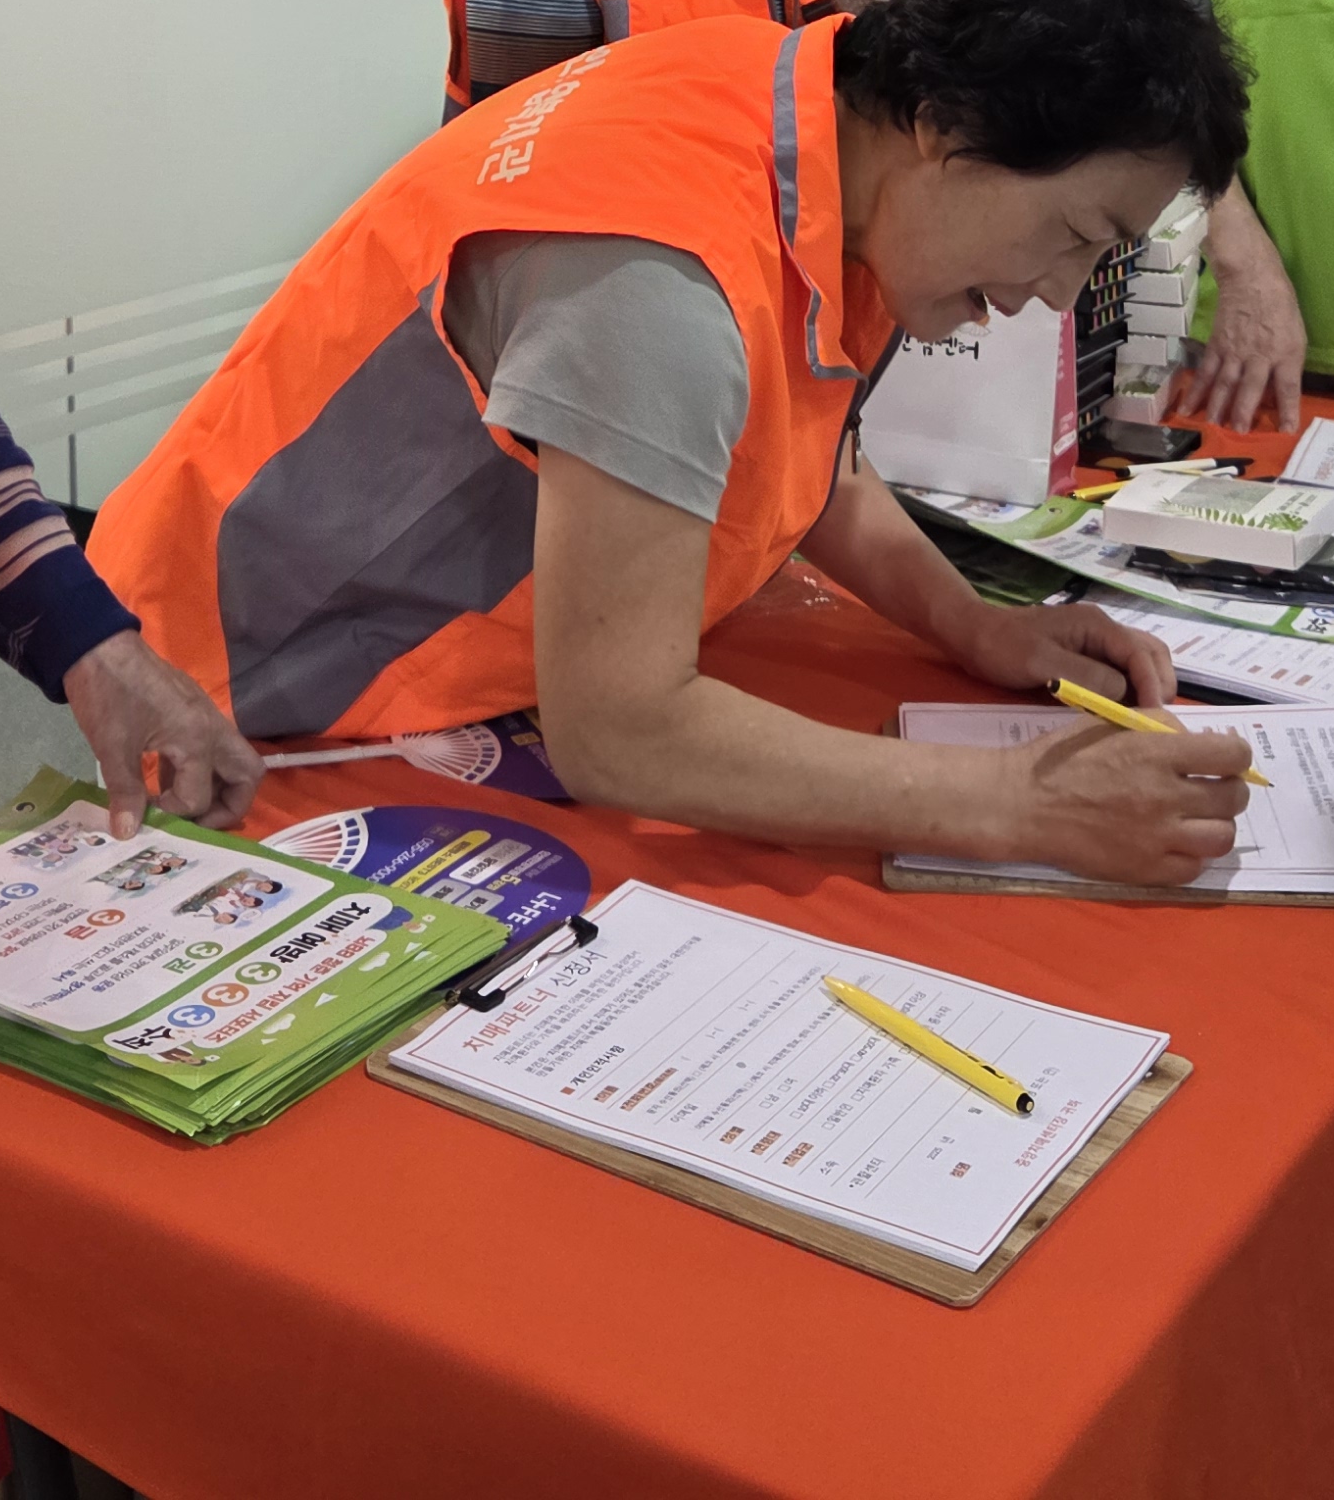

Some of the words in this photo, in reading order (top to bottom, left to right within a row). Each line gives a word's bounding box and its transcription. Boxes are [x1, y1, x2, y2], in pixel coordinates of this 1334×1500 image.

[309, 900, 377, 935] 치매
[264, 929, 333, 964] 예방
[455, 986, 561, 1054] 치매파트너
[542, 948, 612, 989] 신청서
[111, 1022, 180, 1051] 수칙
[566, 1043, 628, 1087] 개인인적사항
